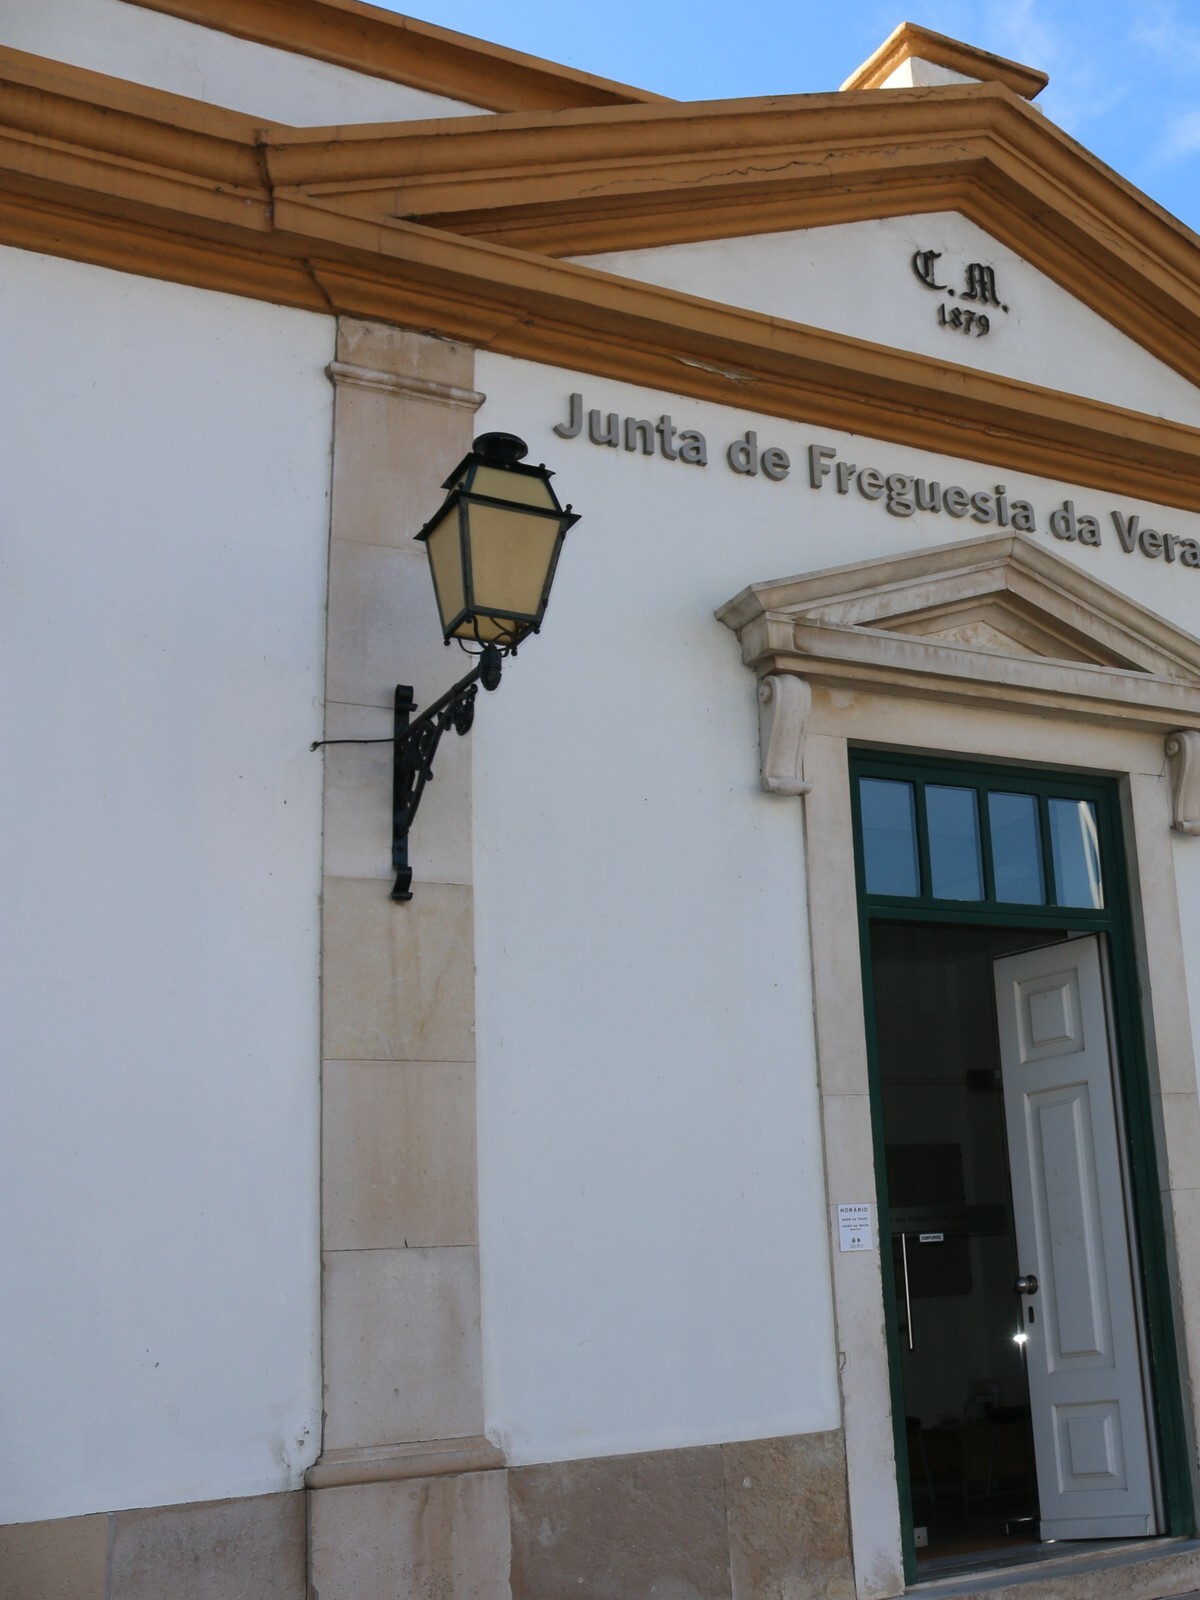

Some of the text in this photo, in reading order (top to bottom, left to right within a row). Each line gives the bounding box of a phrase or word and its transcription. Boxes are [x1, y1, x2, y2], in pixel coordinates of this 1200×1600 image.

[938, 302, 990, 338] 1879
[554, 393, 707, 466] Junta
[728, 431, 791, 481] de
[808, 444, 1036, 533] Freguesia
[1050, 501, 1102, 547] da
